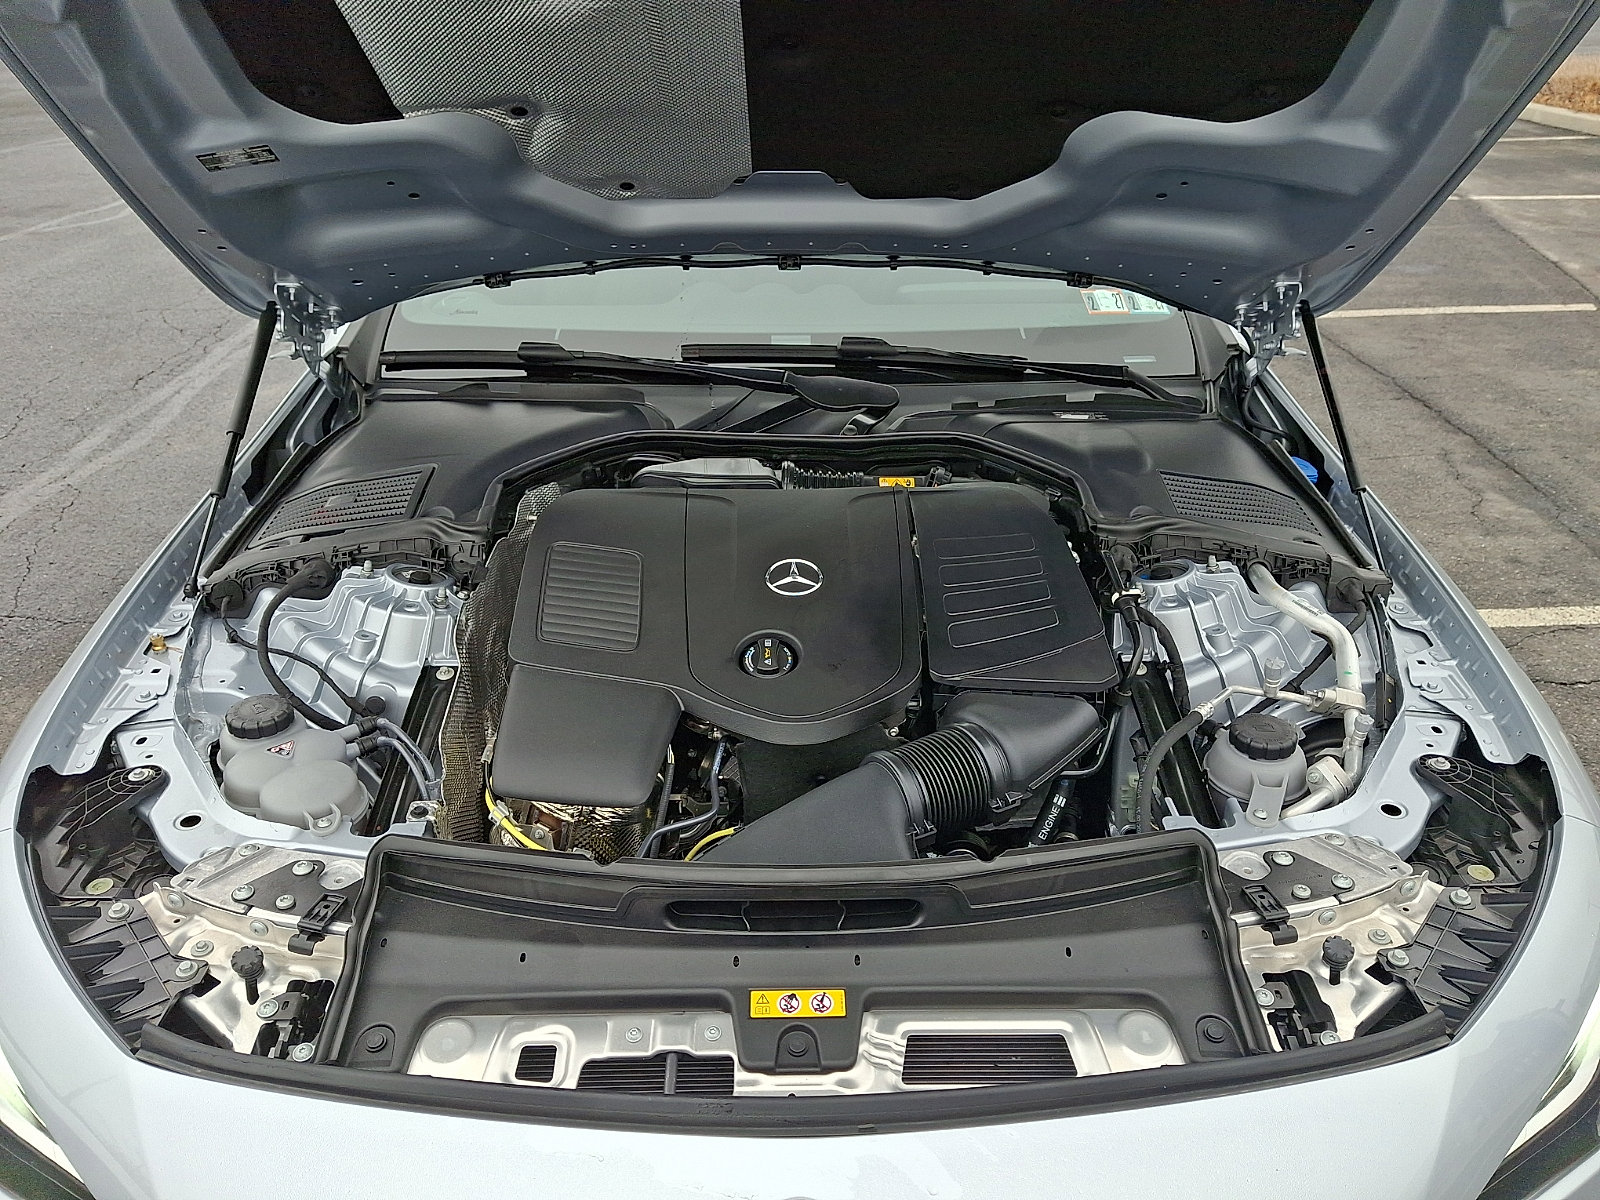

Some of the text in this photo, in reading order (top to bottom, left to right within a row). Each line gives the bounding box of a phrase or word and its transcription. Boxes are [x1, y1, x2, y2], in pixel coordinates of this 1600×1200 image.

[1087, 296, 1097, 310] 2
[1112, 293, 1124, 310] 27
[1128, 296, 1139, 310] 2
[1038, 805, 1060, 840] ENGINE
